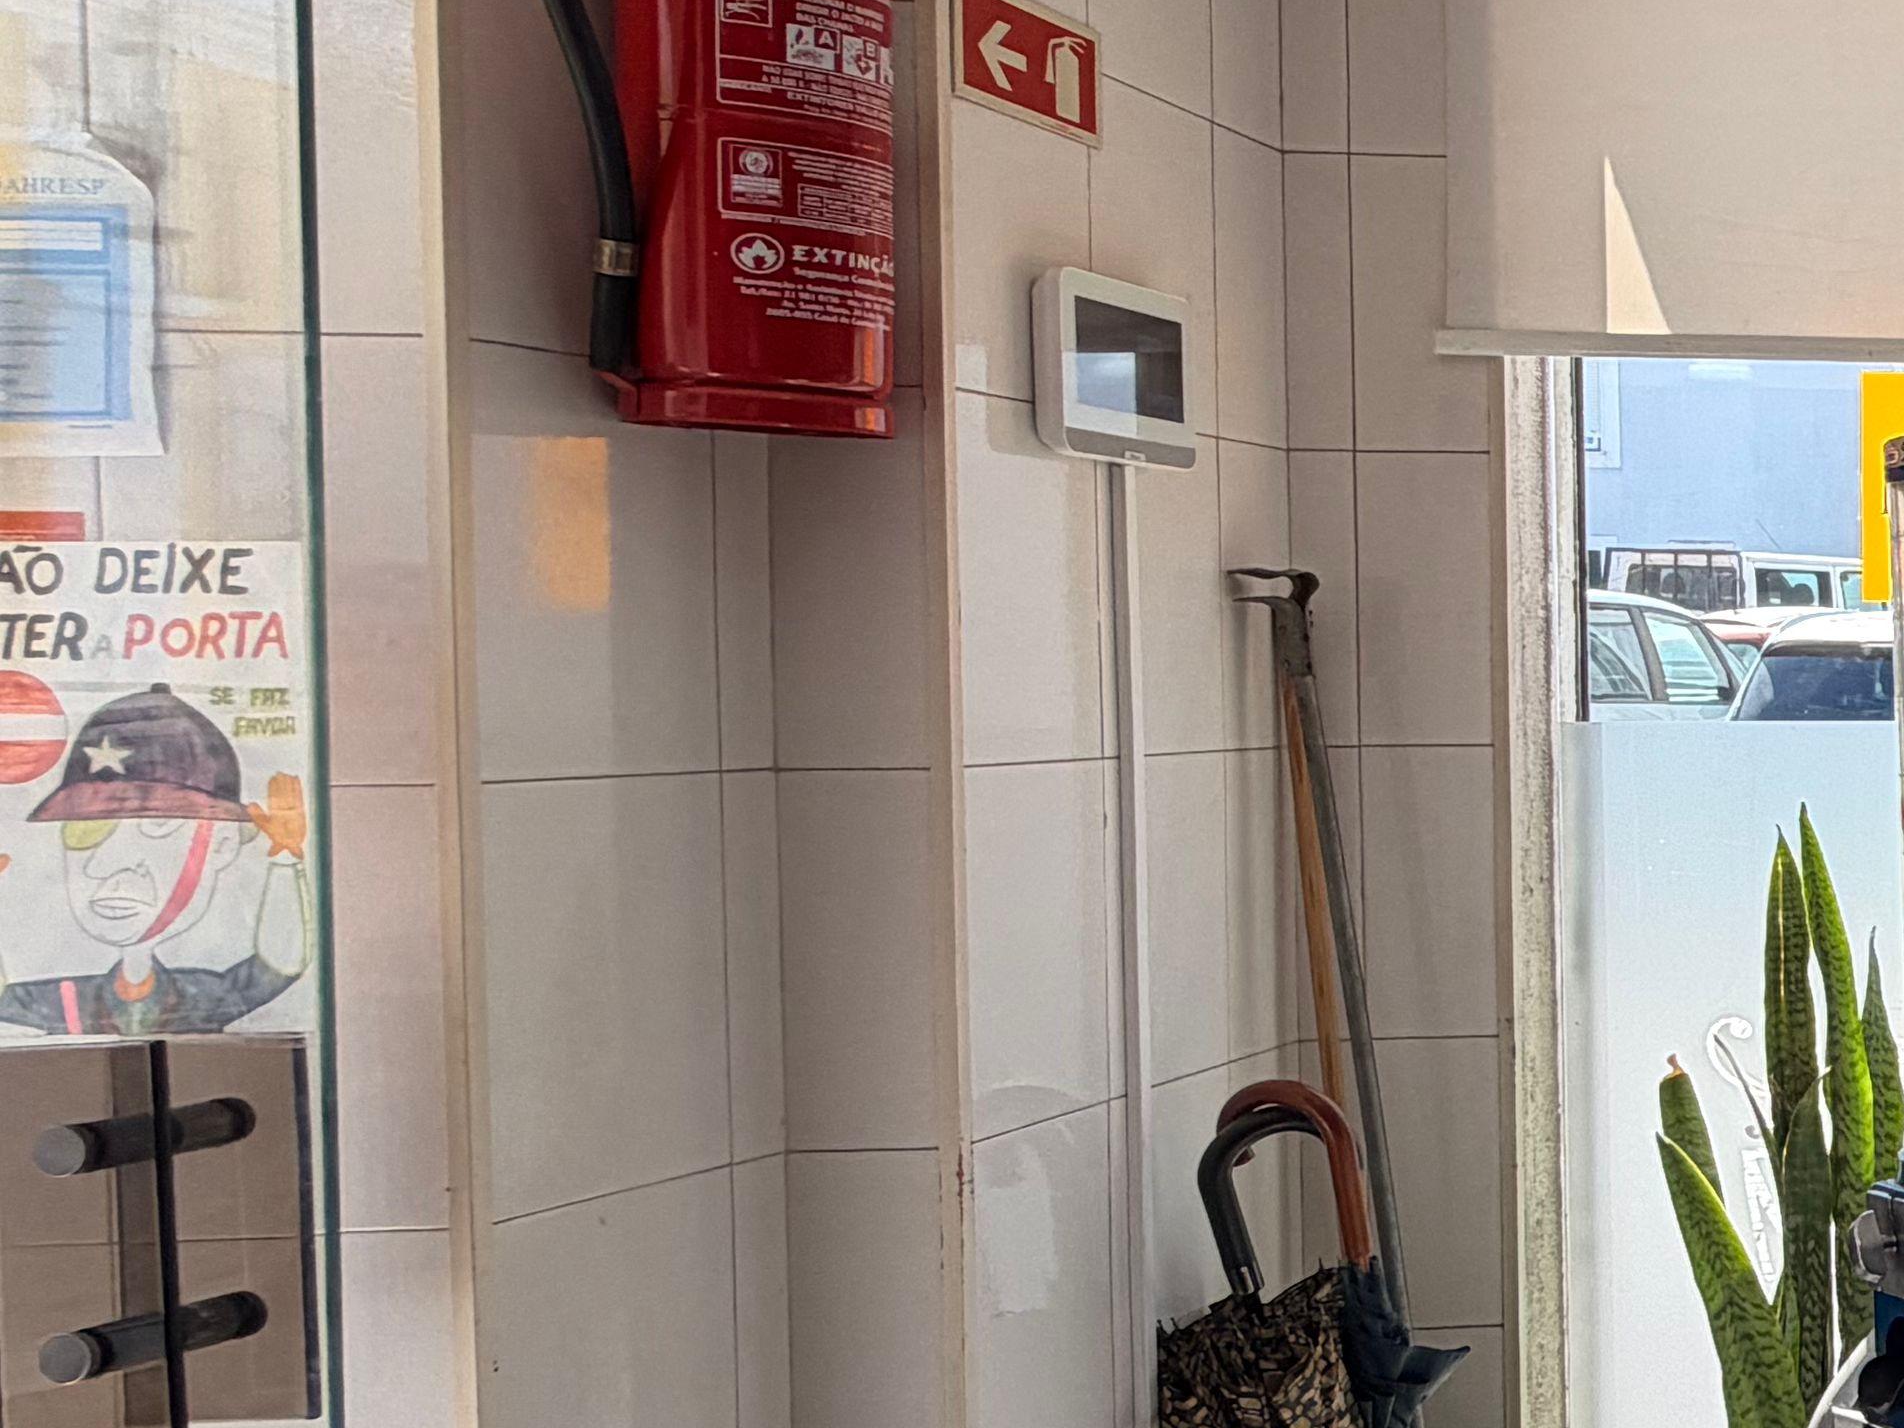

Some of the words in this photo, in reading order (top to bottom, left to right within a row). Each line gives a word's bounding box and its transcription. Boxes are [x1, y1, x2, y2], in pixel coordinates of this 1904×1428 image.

[818, 30, 834, 48] A
[94, 541, 254, 596] DEIXE
[122, 610, 290, 660] PORTA
[208, 686, 235, 706] SE
